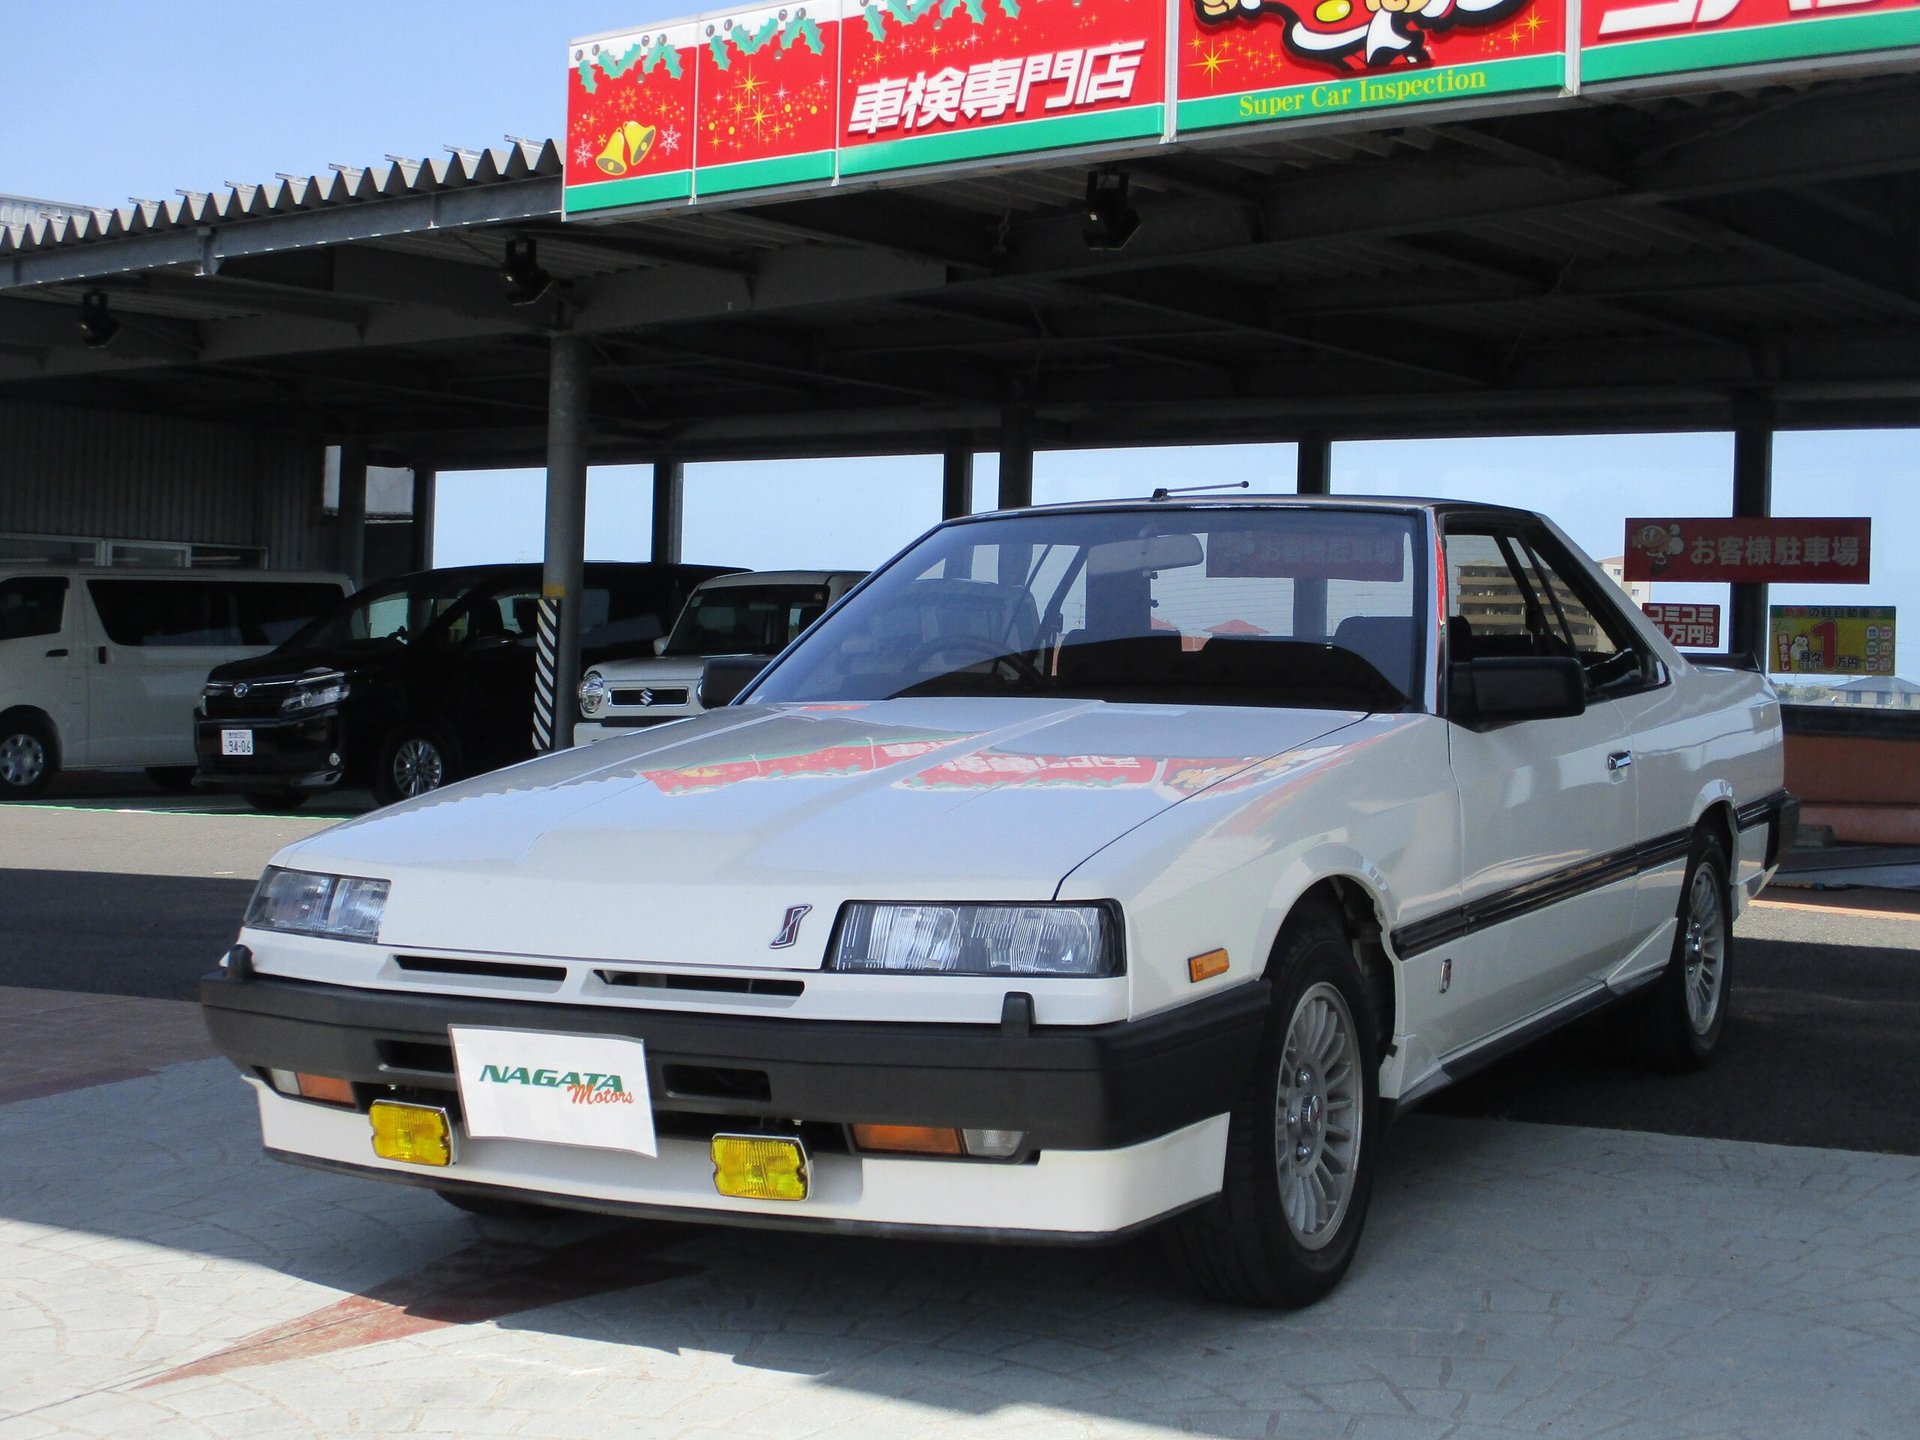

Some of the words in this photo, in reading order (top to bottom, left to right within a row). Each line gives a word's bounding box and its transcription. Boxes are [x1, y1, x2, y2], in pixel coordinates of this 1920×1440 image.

[848, 40, 1146, 134] 車検専門店
[1239, 90, 1305, 116] Super
[1311, 84, 1352, 108] Car
[1359, 71, 1487, 103] Inspection
[1690, 535, 1860, 567] お客様駐車場
[1648, 606, 1714, 623] コミコミ
[479, 1064, 624, 1093] NAGATA
[567, 1083, 634, 1104] Motors
